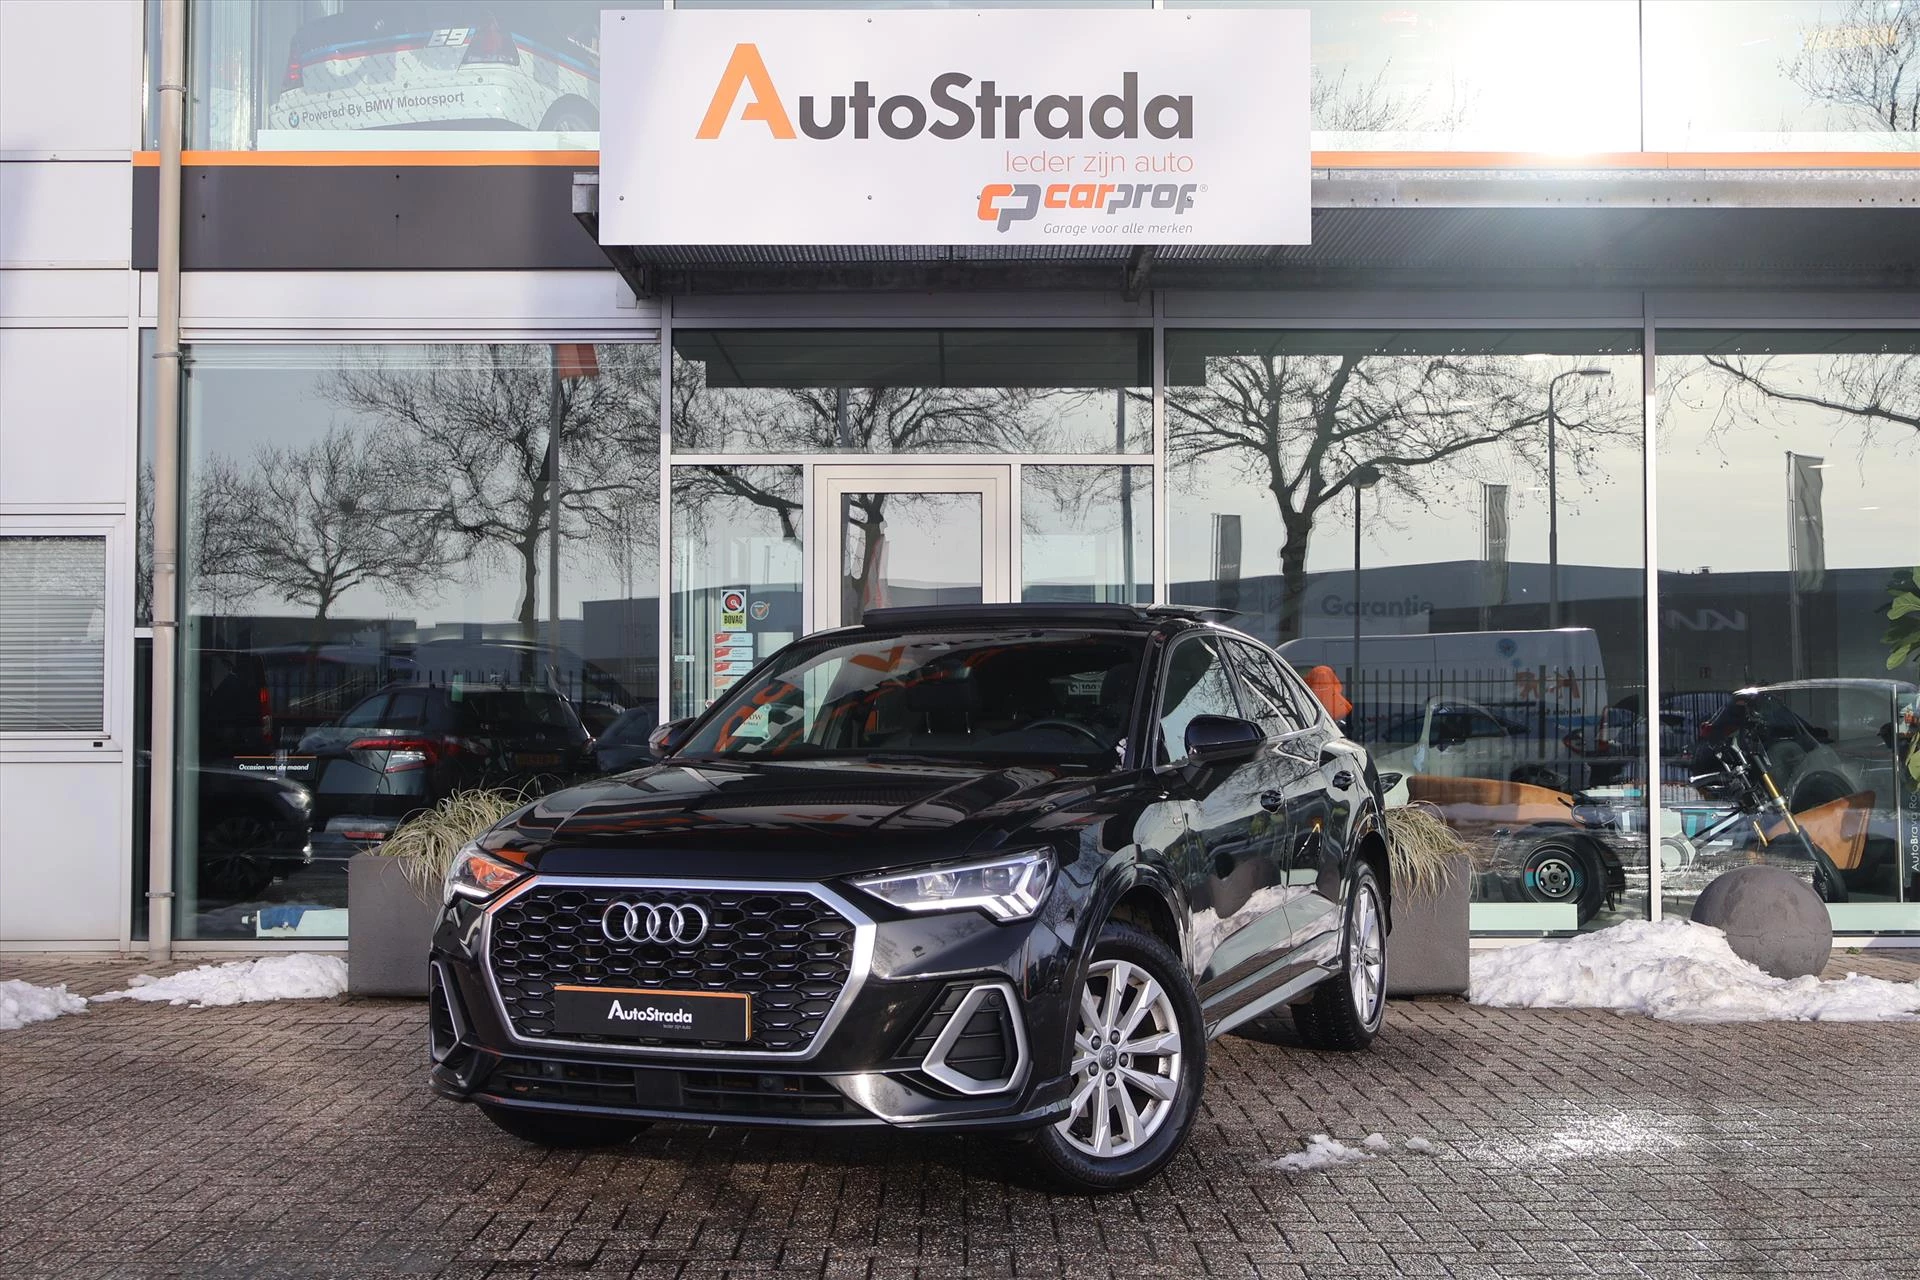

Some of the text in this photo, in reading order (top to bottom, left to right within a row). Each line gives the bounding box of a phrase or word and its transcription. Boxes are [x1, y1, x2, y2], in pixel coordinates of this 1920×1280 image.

[428, 28, 469, 47] 69
[695, 43, 1194, 140] AutoStrada
[302, 91, 465, 123] Powered By BMW Motorsport
[1006, 150, 1194, 178] Ieder zijn auto
[1043, 223, 1193, 236] Garage voor alle merken
[1321, 594, 1435, 617] Garantie
[723, 615, 743, 624] BOVAG
[239, 763, 265, 771] Occasion
[278, 763, 287, 771] de
[287, 763, 309, 771] maand
[1910, 813, 1919, 872] AutoBrava
[607, 999, 692, 1023] AutoStrada
